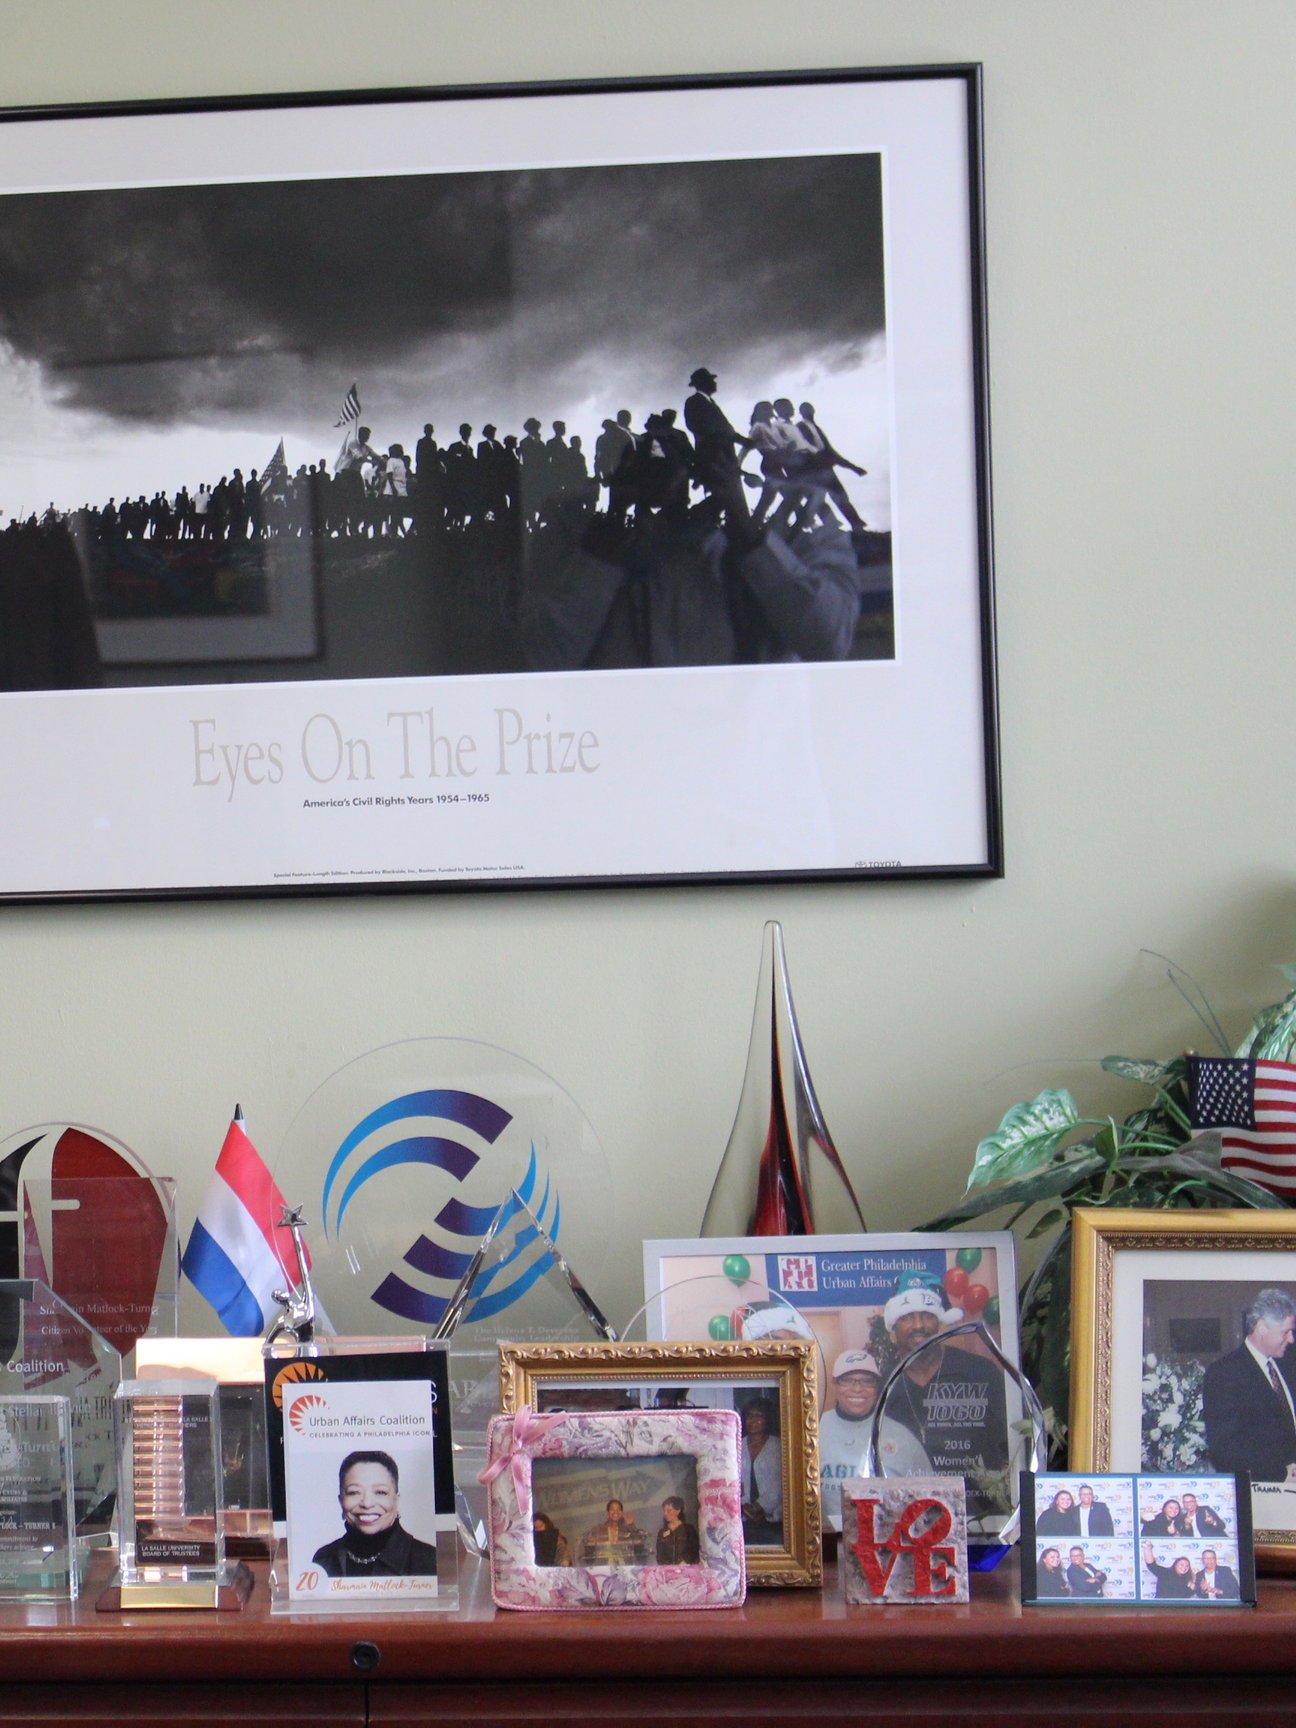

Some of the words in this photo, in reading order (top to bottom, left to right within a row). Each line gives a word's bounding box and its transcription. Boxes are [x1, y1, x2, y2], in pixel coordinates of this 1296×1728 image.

[189, 719, 284, 803] Eyes
[301, 713, 376, 784] On
[387, 706, 479, 780] The
[493, 708, 601, 776] Prize
[303, 798, 351, 809] America's
[352, 797, 373, 807] Civil
[375, 796, 406, 808] Rights
[407, 796, 434, 805] Years
[868, 860, 902, 869] TOYOTA
[821, 1259, 860, 1272] Greater
[863, 1257, 927, 1271] Philadelphia
[822, 1277, 856, 1289] Urban
[859, 1275, 892, 1288] Affairs
[114, 1324, 124, 1333] of
[125, 1324, 137, 1333] the
[6, 1360, 65, 1373] Coalition
[927, 1383, 989, 1400] KYW
[309, 1416, 340, 1427] Urban
[343, 1415, 376, 1426] Affairs
[379, 1415, 425, 1425] Coalition
[944, 1440, 971, 1450] 2016
[24, 1522, 50, 1530] TURNER
[296, 1572, 319, 1592] 20
